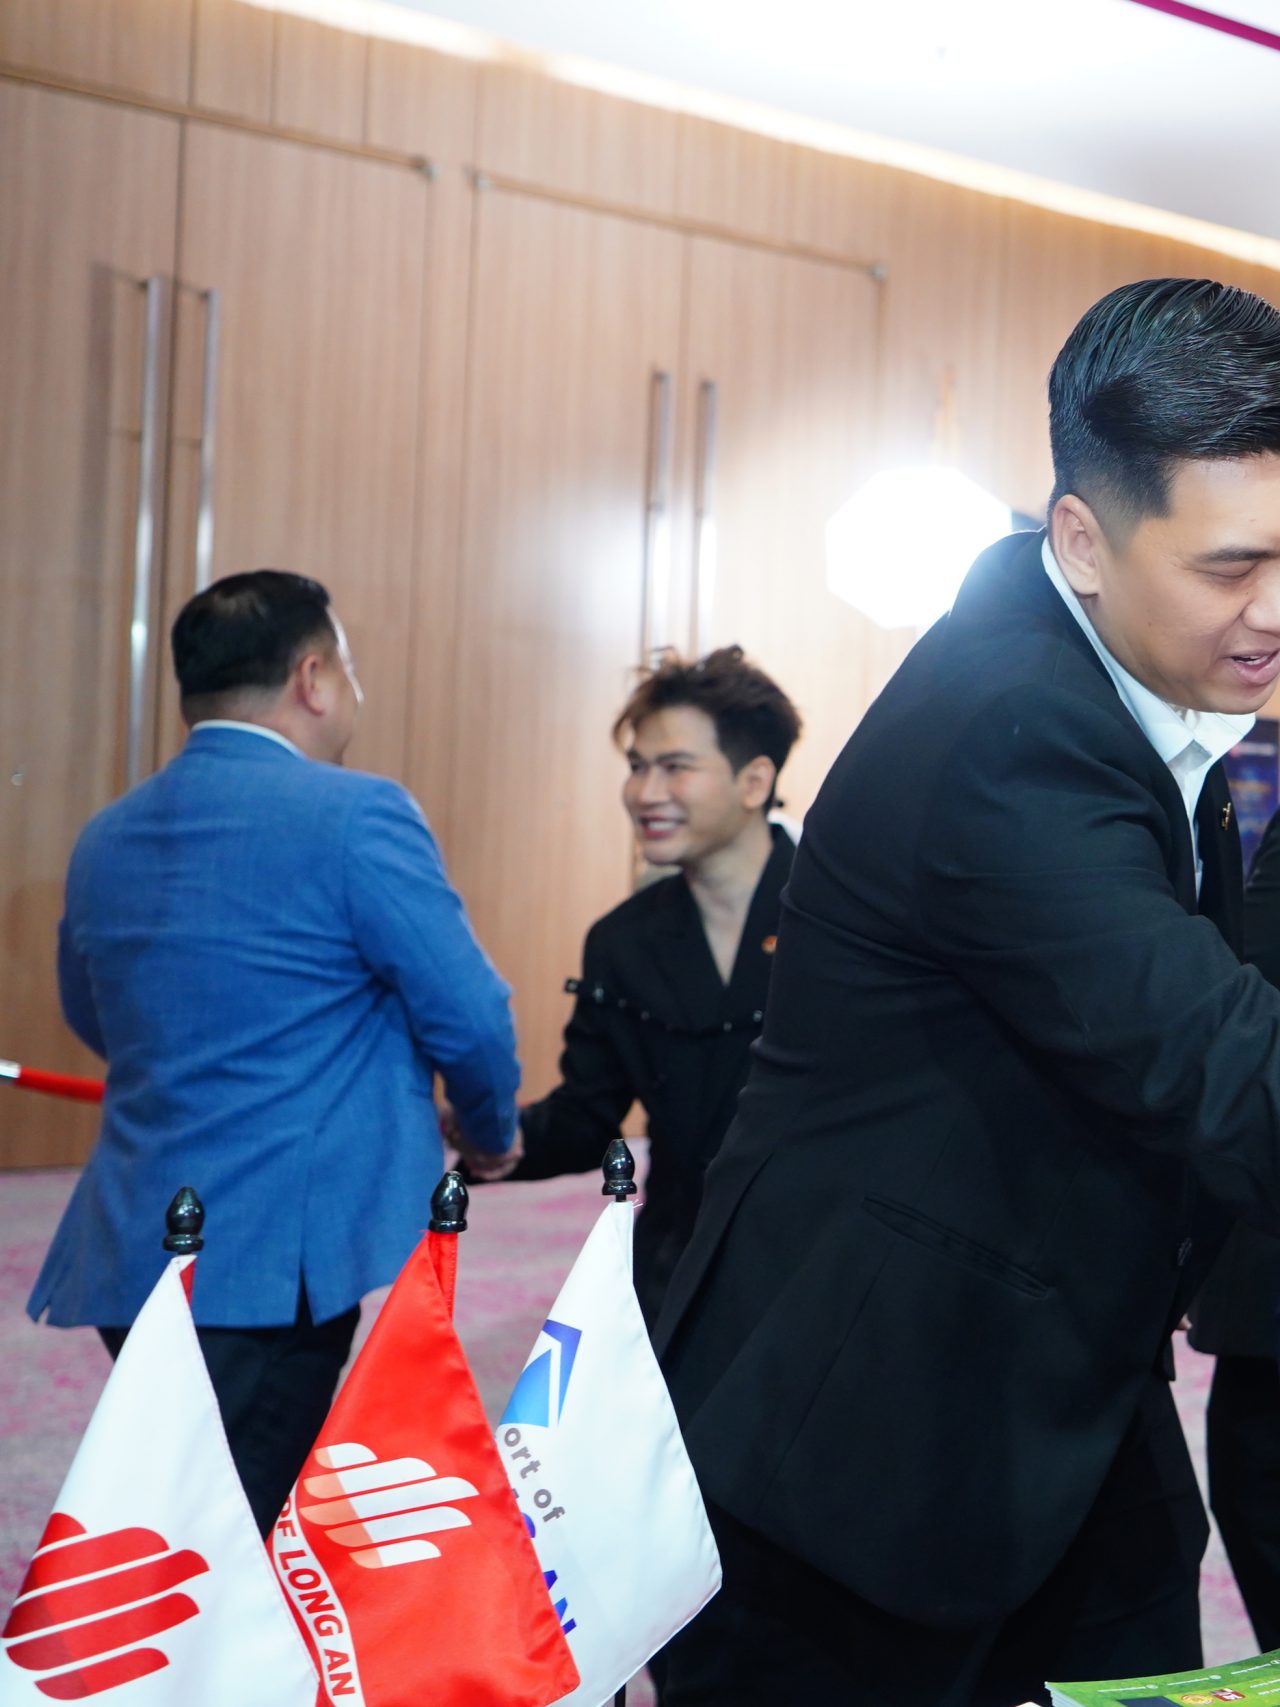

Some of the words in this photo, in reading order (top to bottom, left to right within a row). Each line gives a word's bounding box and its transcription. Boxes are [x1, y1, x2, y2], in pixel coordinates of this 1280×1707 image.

[504, 1427, 541, 1480] ort
[533, 1488, 566, 1524] of
[278, 1549, 344, 1638] LONG
[323, 1648, 356, 1697] AN
